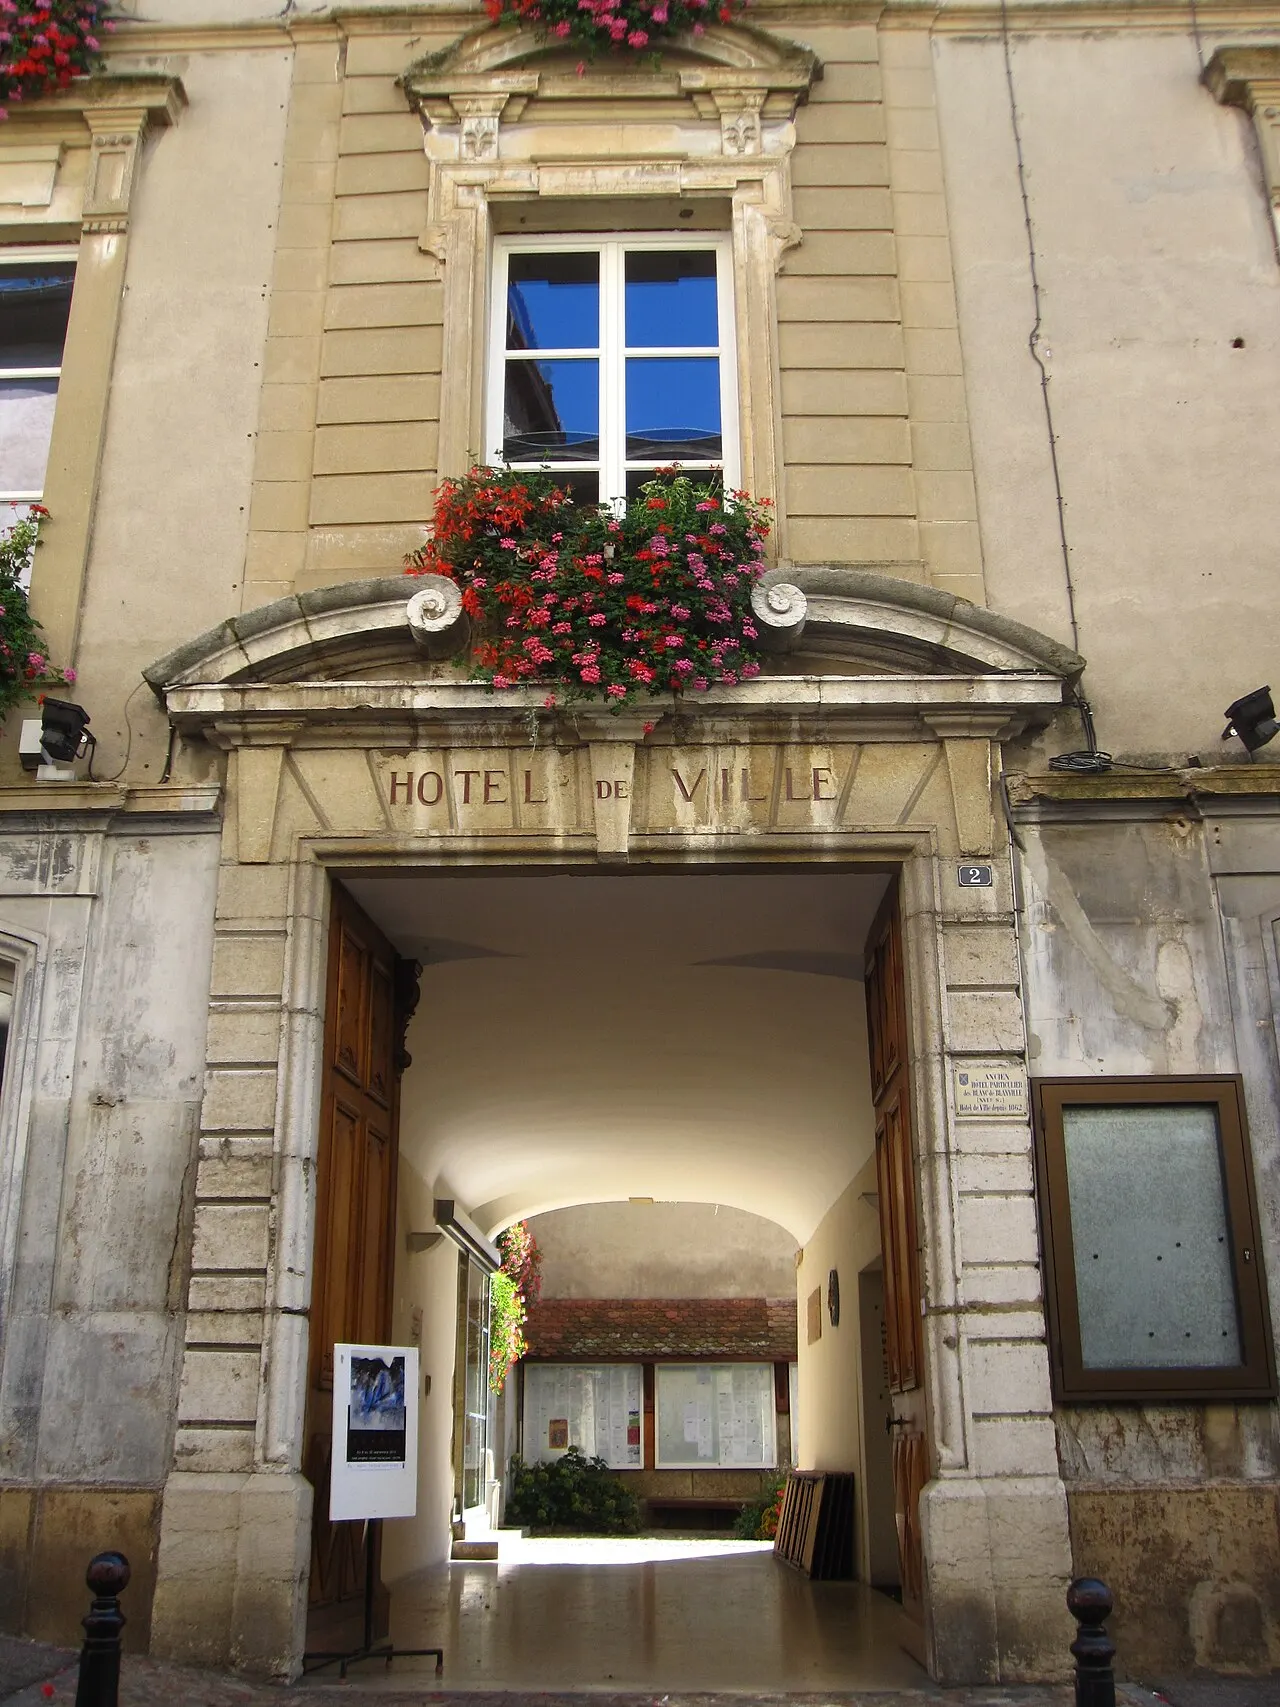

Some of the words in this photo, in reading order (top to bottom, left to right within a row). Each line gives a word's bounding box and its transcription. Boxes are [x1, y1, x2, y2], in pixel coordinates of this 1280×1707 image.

[389, 770, 548, 806] HOTEL
[596, 779, 629, 799] DE
[671, 767, 837, 803] VILLE
[969, 868, 981, 883] 2
